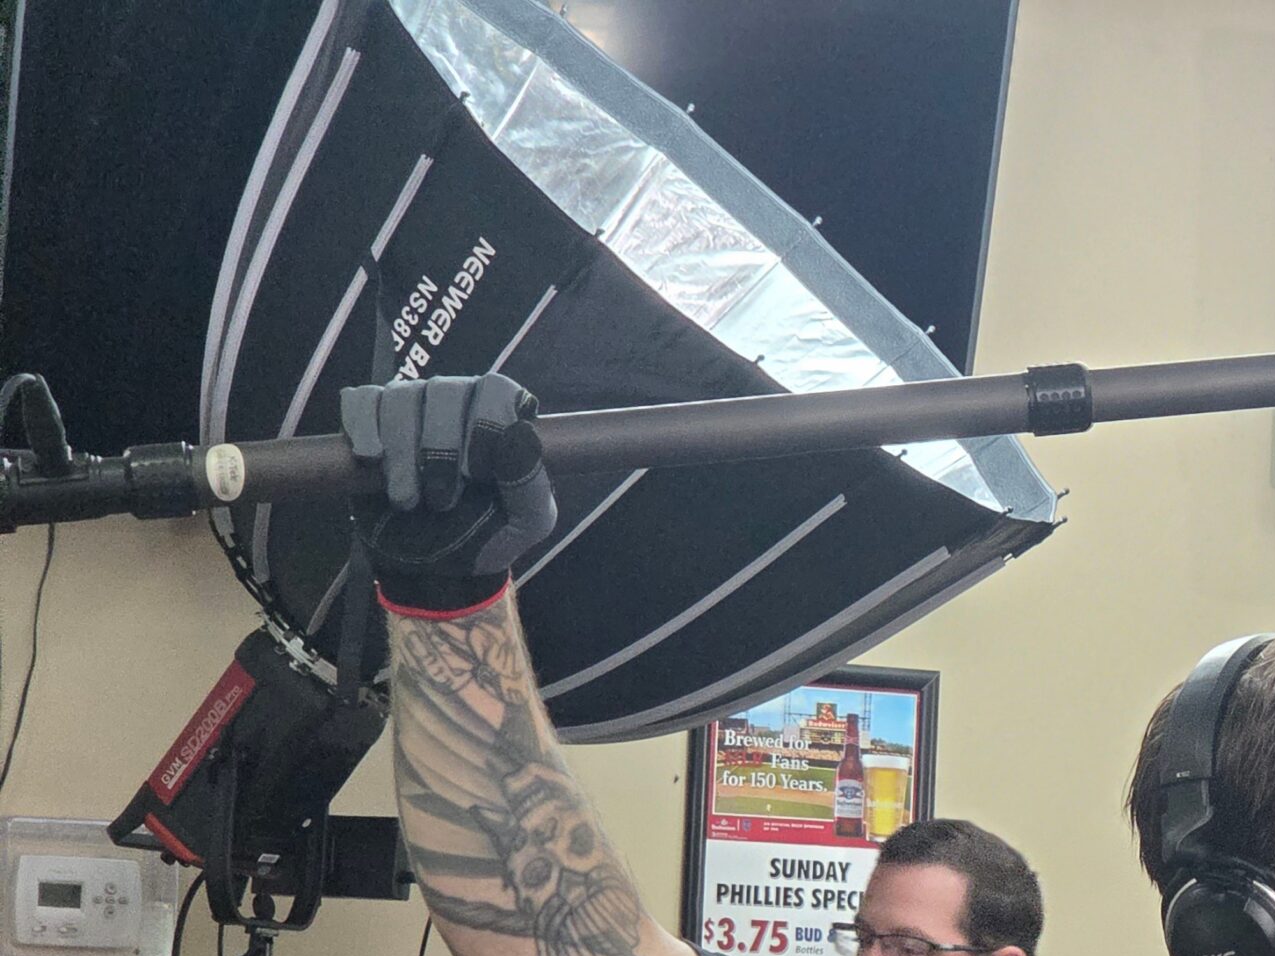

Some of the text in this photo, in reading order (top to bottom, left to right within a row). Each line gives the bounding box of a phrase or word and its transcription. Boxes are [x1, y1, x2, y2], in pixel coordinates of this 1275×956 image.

[723, 729, 812, 751] Brewed for
[161, 757, 184, 785] GVM
[771, 752, 810, 772] Fans
[722, 771, 829, 794] for 150 Years.
[769, 857, 852, 884] SUNDAY
[716, 883, 805, 909] PHILLIES
[703, 916, 790, 956] $3.75
[795, 927, 823, 943] BUD
[795, 945, 824, 956] Bottles
